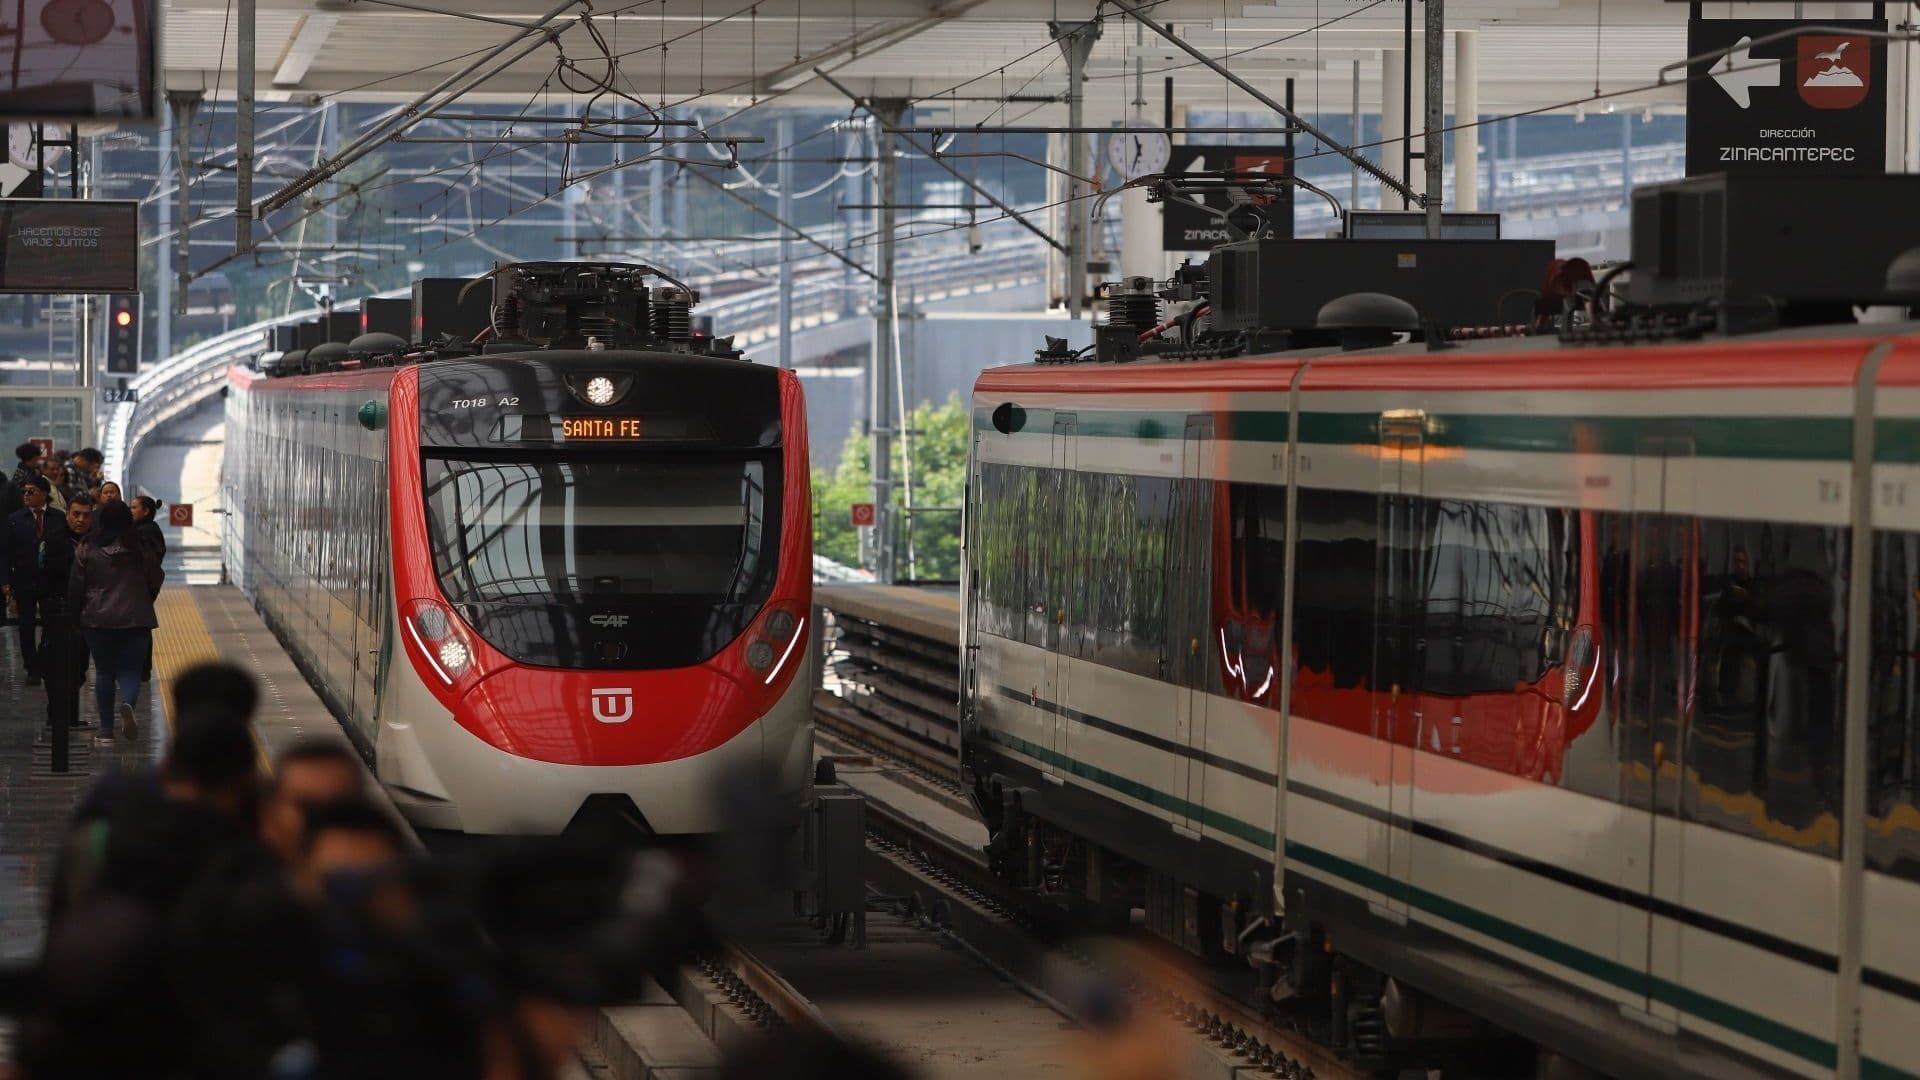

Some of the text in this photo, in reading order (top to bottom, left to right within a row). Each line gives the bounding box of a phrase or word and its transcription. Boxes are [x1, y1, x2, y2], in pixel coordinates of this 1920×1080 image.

[1759, 127, 1816, 138] DIRECCIÓN
[1719, 147, 1856, 161] ZINACANTEPEC
[18, 226, 102, 237] HACEMOS ESTE
[22, 238, 98, 247] VIAJE JUNTOS
[452, 397, 520, 409] T018 A2
[562, 420, 641, 437] SANTA FE
[589, 614, 630, 628] CAF
